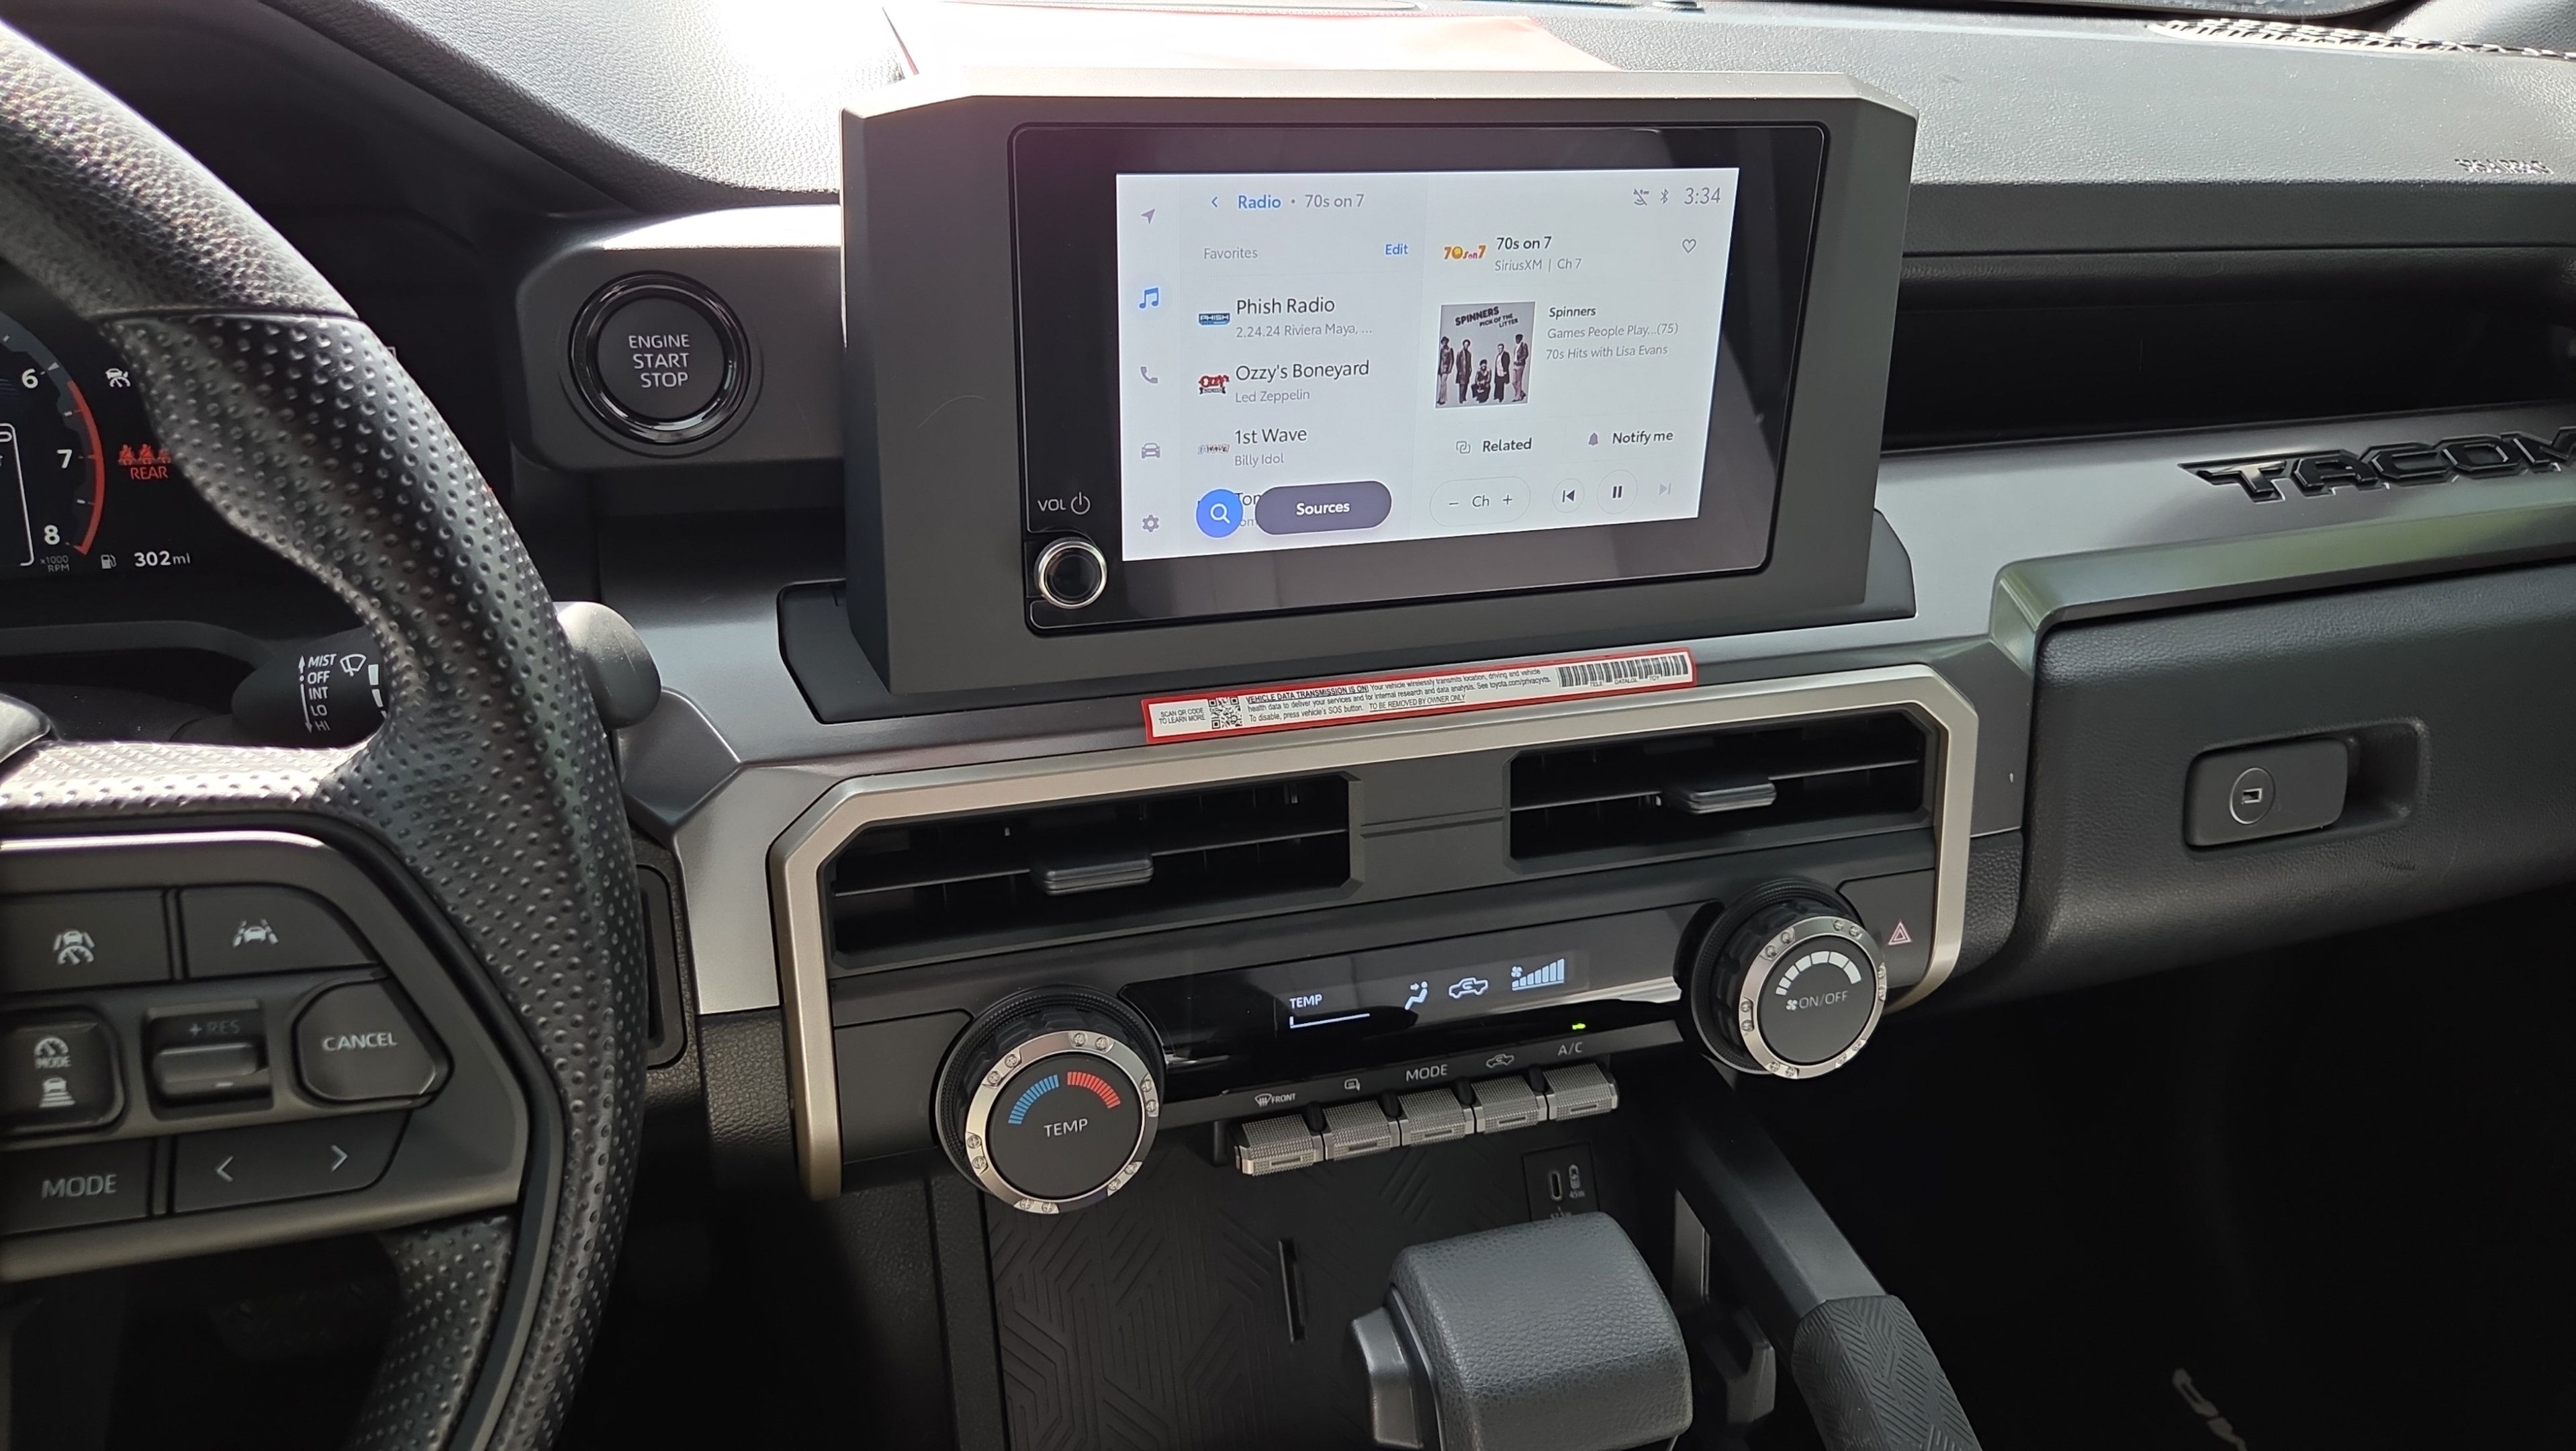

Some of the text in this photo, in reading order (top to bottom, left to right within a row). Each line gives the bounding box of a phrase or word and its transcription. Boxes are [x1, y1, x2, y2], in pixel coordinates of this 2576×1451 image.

[1238, 194, 1365, 209] Radio 70s on 7
[1684, 187, 1721, 204] 3:34
[1385, 244, 1409, 255] Edit
[1497, 236, 1552, 250] 70s on 7
[1203, 247, 1258, 259] Favorites
[1495, 258, 1581, 271] SiriusXM Ch 7
[1236, 296, 1335, 314] Phish Radio
[1549, 306, 1596, 318] Spinners
[1455, 306, 1500, 326] SPINNERS
[1499, 318, 1518, 328] LITTER
[1236, 326, 1280, 338] 2.24.24
[1284, 324, 1322, 336] Riviera
[1326, 323, 1359, 337] Maya,
[1547, 326, 1585, 339] Games
[1588, 325, 1624, 339] People
[629, 334, 690, 349] ENGINE
[1546, 345, 1667, 359] 70s Hits with Lisa Evans
[633, 353, 690, 369] START
[1236, 360, 1369, 383] Ozzy's Boneyard
[21, 369, 38, 389] 6
[641, 371, 688, 388] STOP
[1235, 390, 1310, 404] Led Zeppelin
[1235, 428, 1307, 445] 1st Wave
[1612, 431, 1673, 445] Notify me
[1482, 438, 1532, 452] Related
[56, 449, 73, 468] 7
[1234, 453, 1284, 468] Billy Idol
[130, 466, 169, 480] REAR
[1038, 499, 1066, 511] VOL
[1472, 495, 1489, 507] Ch
[1296, 502, 1350, 516] Sources
[44, 525, 60, 545] 8
[40, 555, 69, 565] x1000
[48, 563, 70, 572] RPM
[308, 654, 336, 668] MIST
[307, 670, 330, 684] OFF
[309, 687, 328, 700] INT
[1246, 694, 1275, 703] VEHICLE
[1277, 692, 1295, 700] DATA
[1297, 687, 1347, 697] TRANSMISSION
[1386, 681, 1406, 689] vehicle
[1248, 704, 1267, 712] health
[1268, 703, 1282, 711] data
[1313, 699, 1325, 707] your
[1328, 696, 1352, 704] services
[1397, 689, 1423, 697] research
[1477, 682, 1488, 690] See
[310, 705, 328, 716] LO
[1249, 714, 1256, 722] To
[1283, 711, 1299, 719] press
[1328, 705, 1342, 714] SOS
[1388, 698, 1417, 707] REMOVED
[1418, 697, 1426, 705] BY
[1427, 695, 1449, 704] OWNER
[1451, 694, 1466, 702] ONLY
[1188, 713, 1206, 721] MORE
[314, 720, 330, 732] HI
[1289, 994, 1322, 1009] TEMP
[1799, 990, 1849, 1008] ON/OFF
[322, 1032, 397, 1052] CANCEL
[1558, 1042, 1583, 1056] A/C
[36, 1055, 71, 1069] MODE
[1406, 1064, 1448, 1082] MODE
[1271, 1093, 1296, 1104] FRONT
[1044, 1118, 1088, 1137] TEMP
[42, 1174, 117, 1200] MODE
